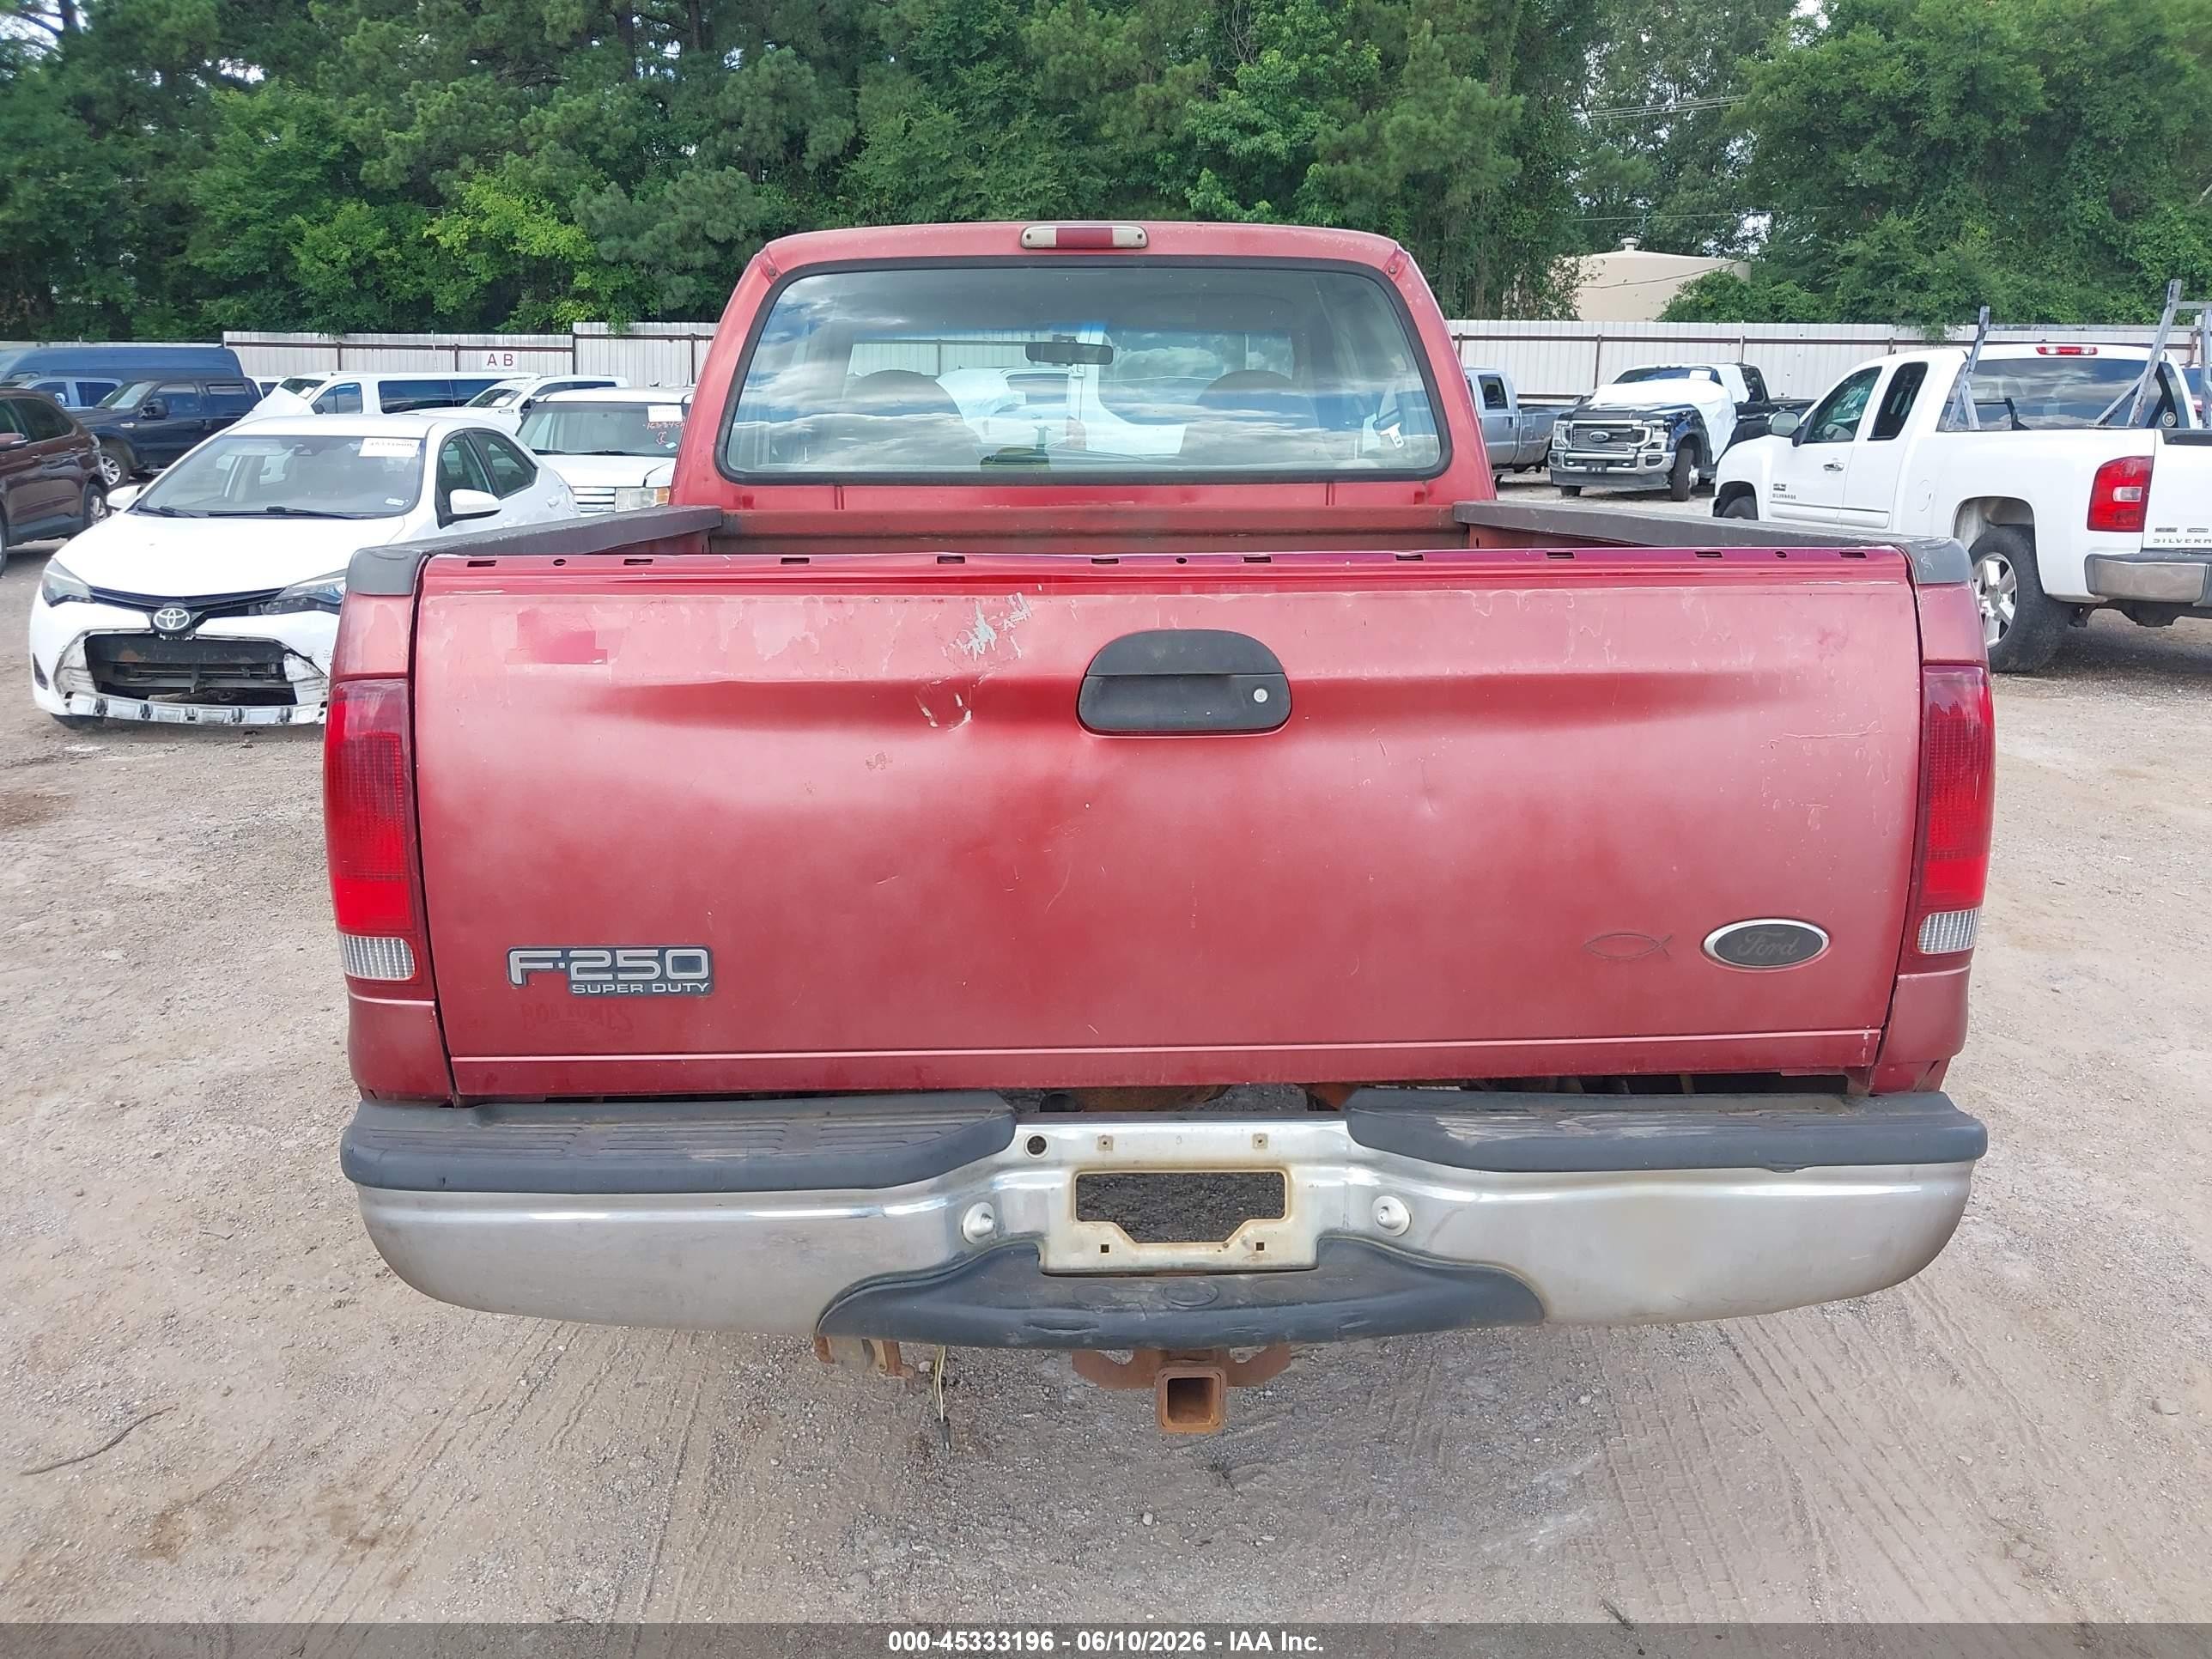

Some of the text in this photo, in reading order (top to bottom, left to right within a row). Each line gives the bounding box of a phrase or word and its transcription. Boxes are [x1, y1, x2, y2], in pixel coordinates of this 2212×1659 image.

[487, 353, 514, 367] A B
[1737, 930, 1801, 957] Ford
[572, 982, 710, 994] SUPER DUTY
